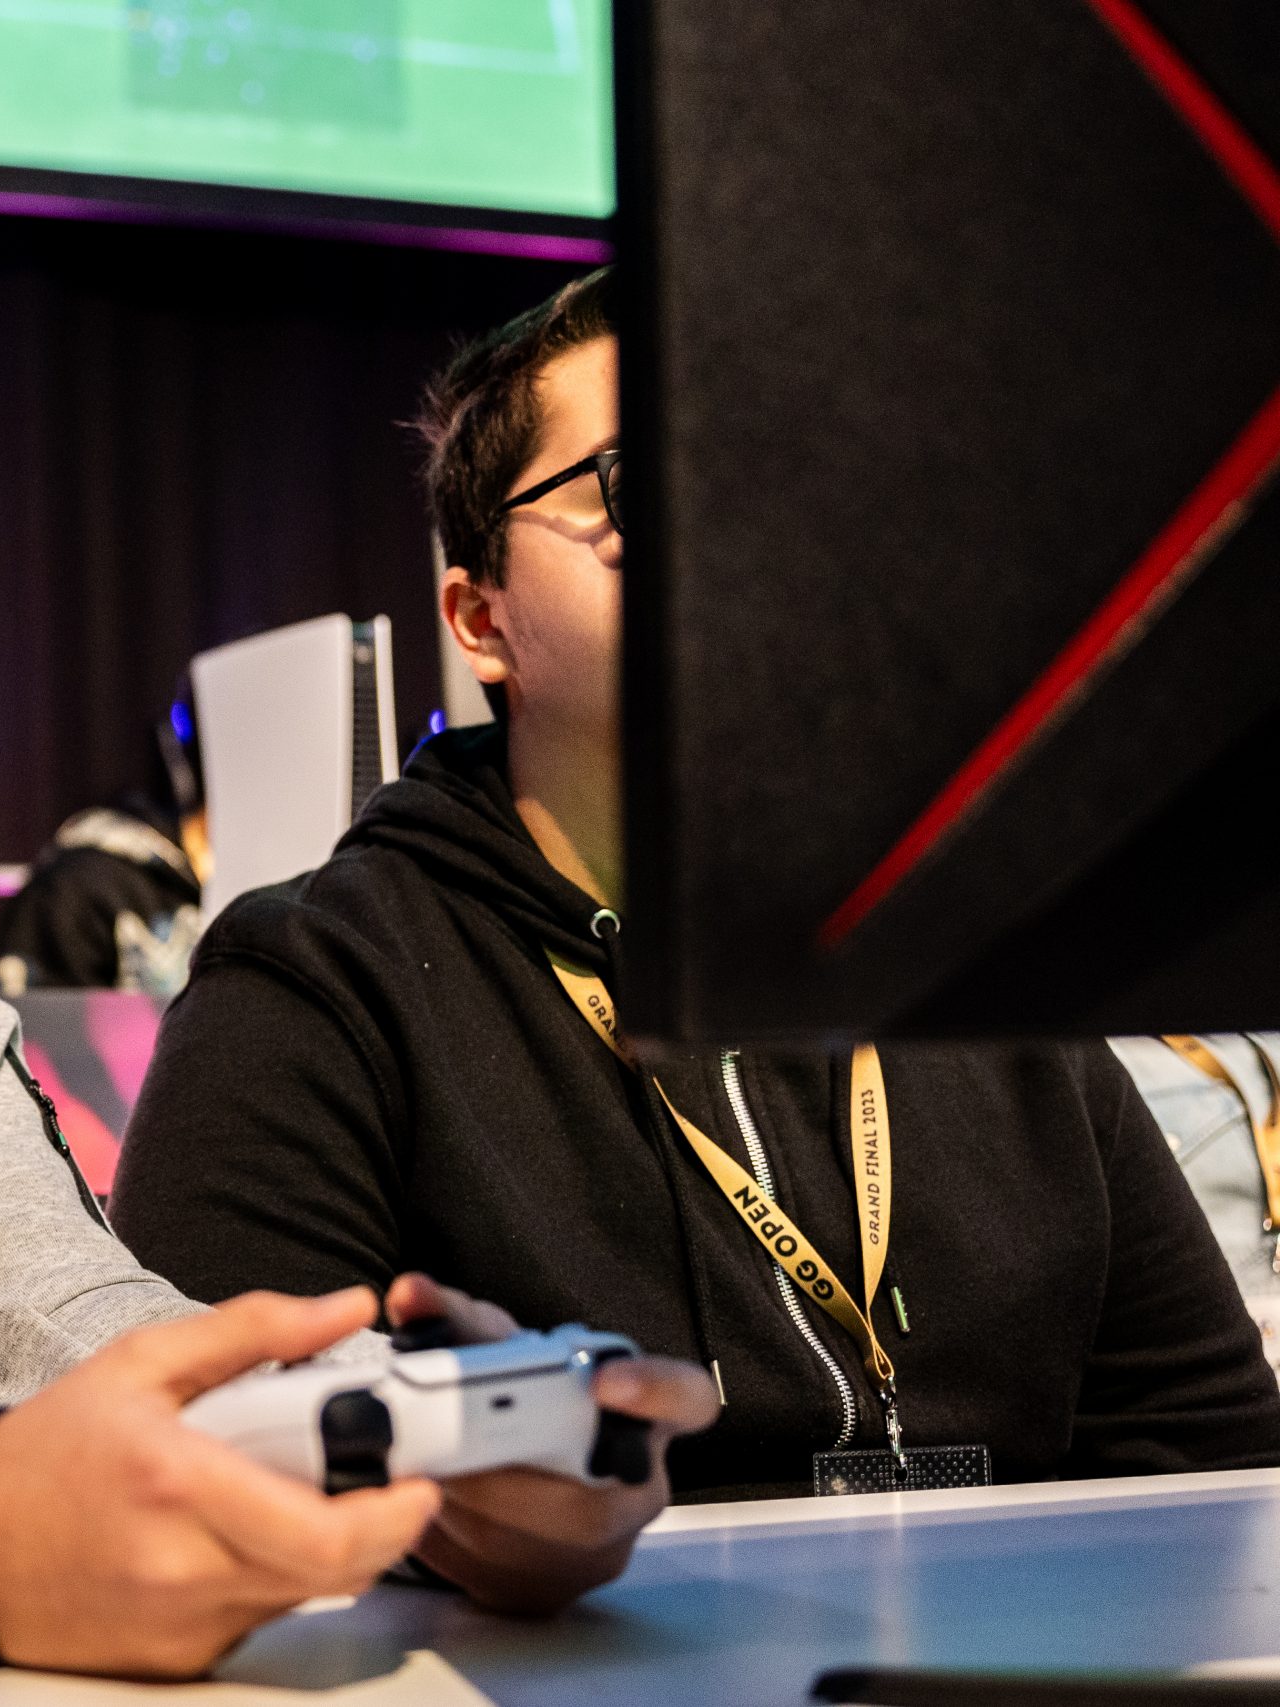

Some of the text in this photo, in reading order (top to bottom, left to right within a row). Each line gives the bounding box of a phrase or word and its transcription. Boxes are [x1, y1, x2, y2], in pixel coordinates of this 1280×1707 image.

[861, 1089, 880, 1245] GRAND FINAL 2023
[733, 1185, 835, 1301] GG OPEN
